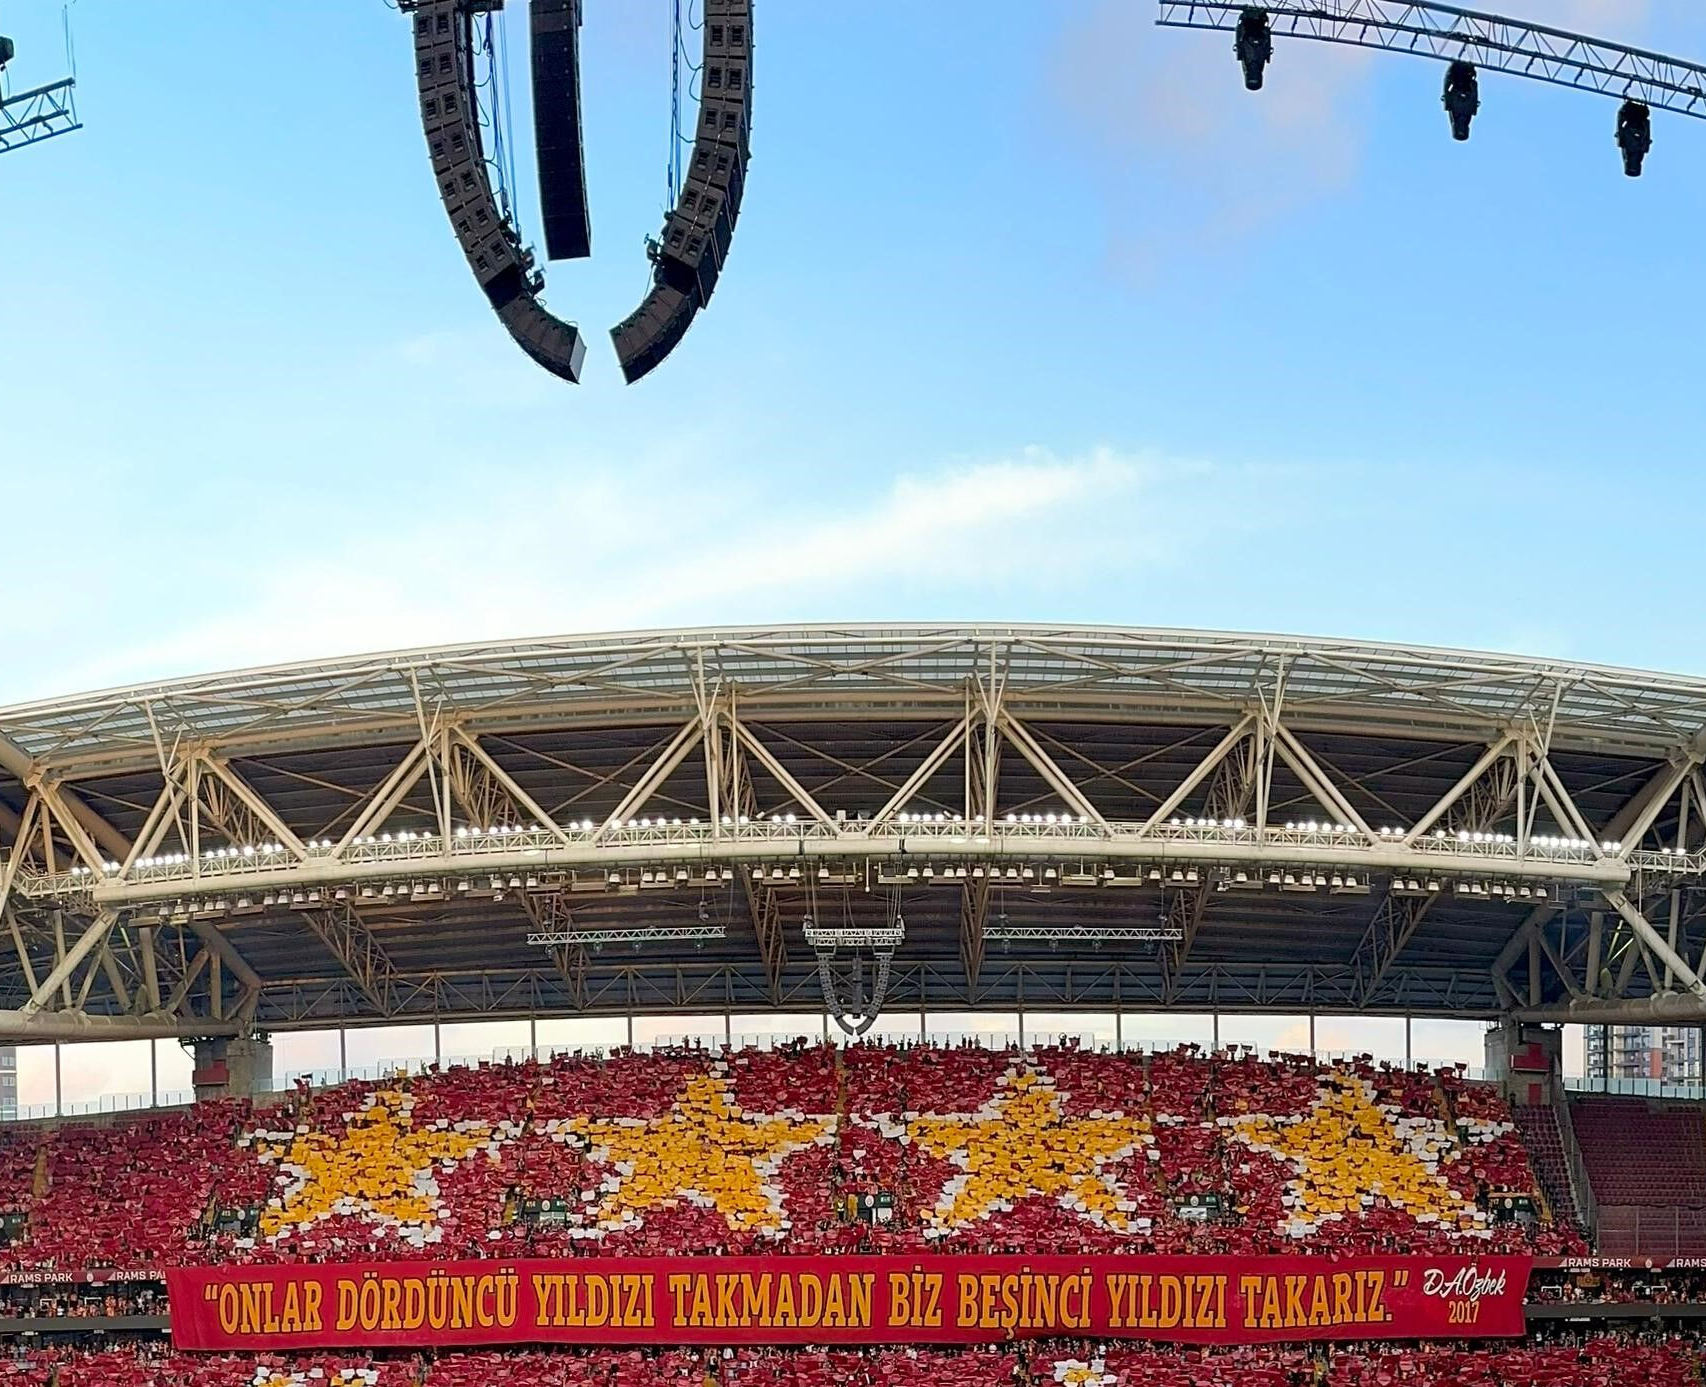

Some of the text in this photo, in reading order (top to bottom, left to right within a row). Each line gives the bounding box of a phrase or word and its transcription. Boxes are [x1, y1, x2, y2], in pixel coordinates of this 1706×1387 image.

[1568, 1258, 1631, 1268] RAMS PARK
[10, 1273, 73, 1284] RAMS PARK
[116, 1271, 145, 1281] RAMS
[336, 1268, 519, 1333] DÖRDÜNCÜ
[532, 1273, 655, 1329] YILDIZI
[669, 1273, 874, 1329] TAKMADAN
[888, 1264, 942, 1329] BİZ
[956, 1264, 1093, 1341] BEŞİNCİ
[1106, 1273, 1228, 1329] YILDIZI
[1447, 1301, 1480, 1325] 2017
